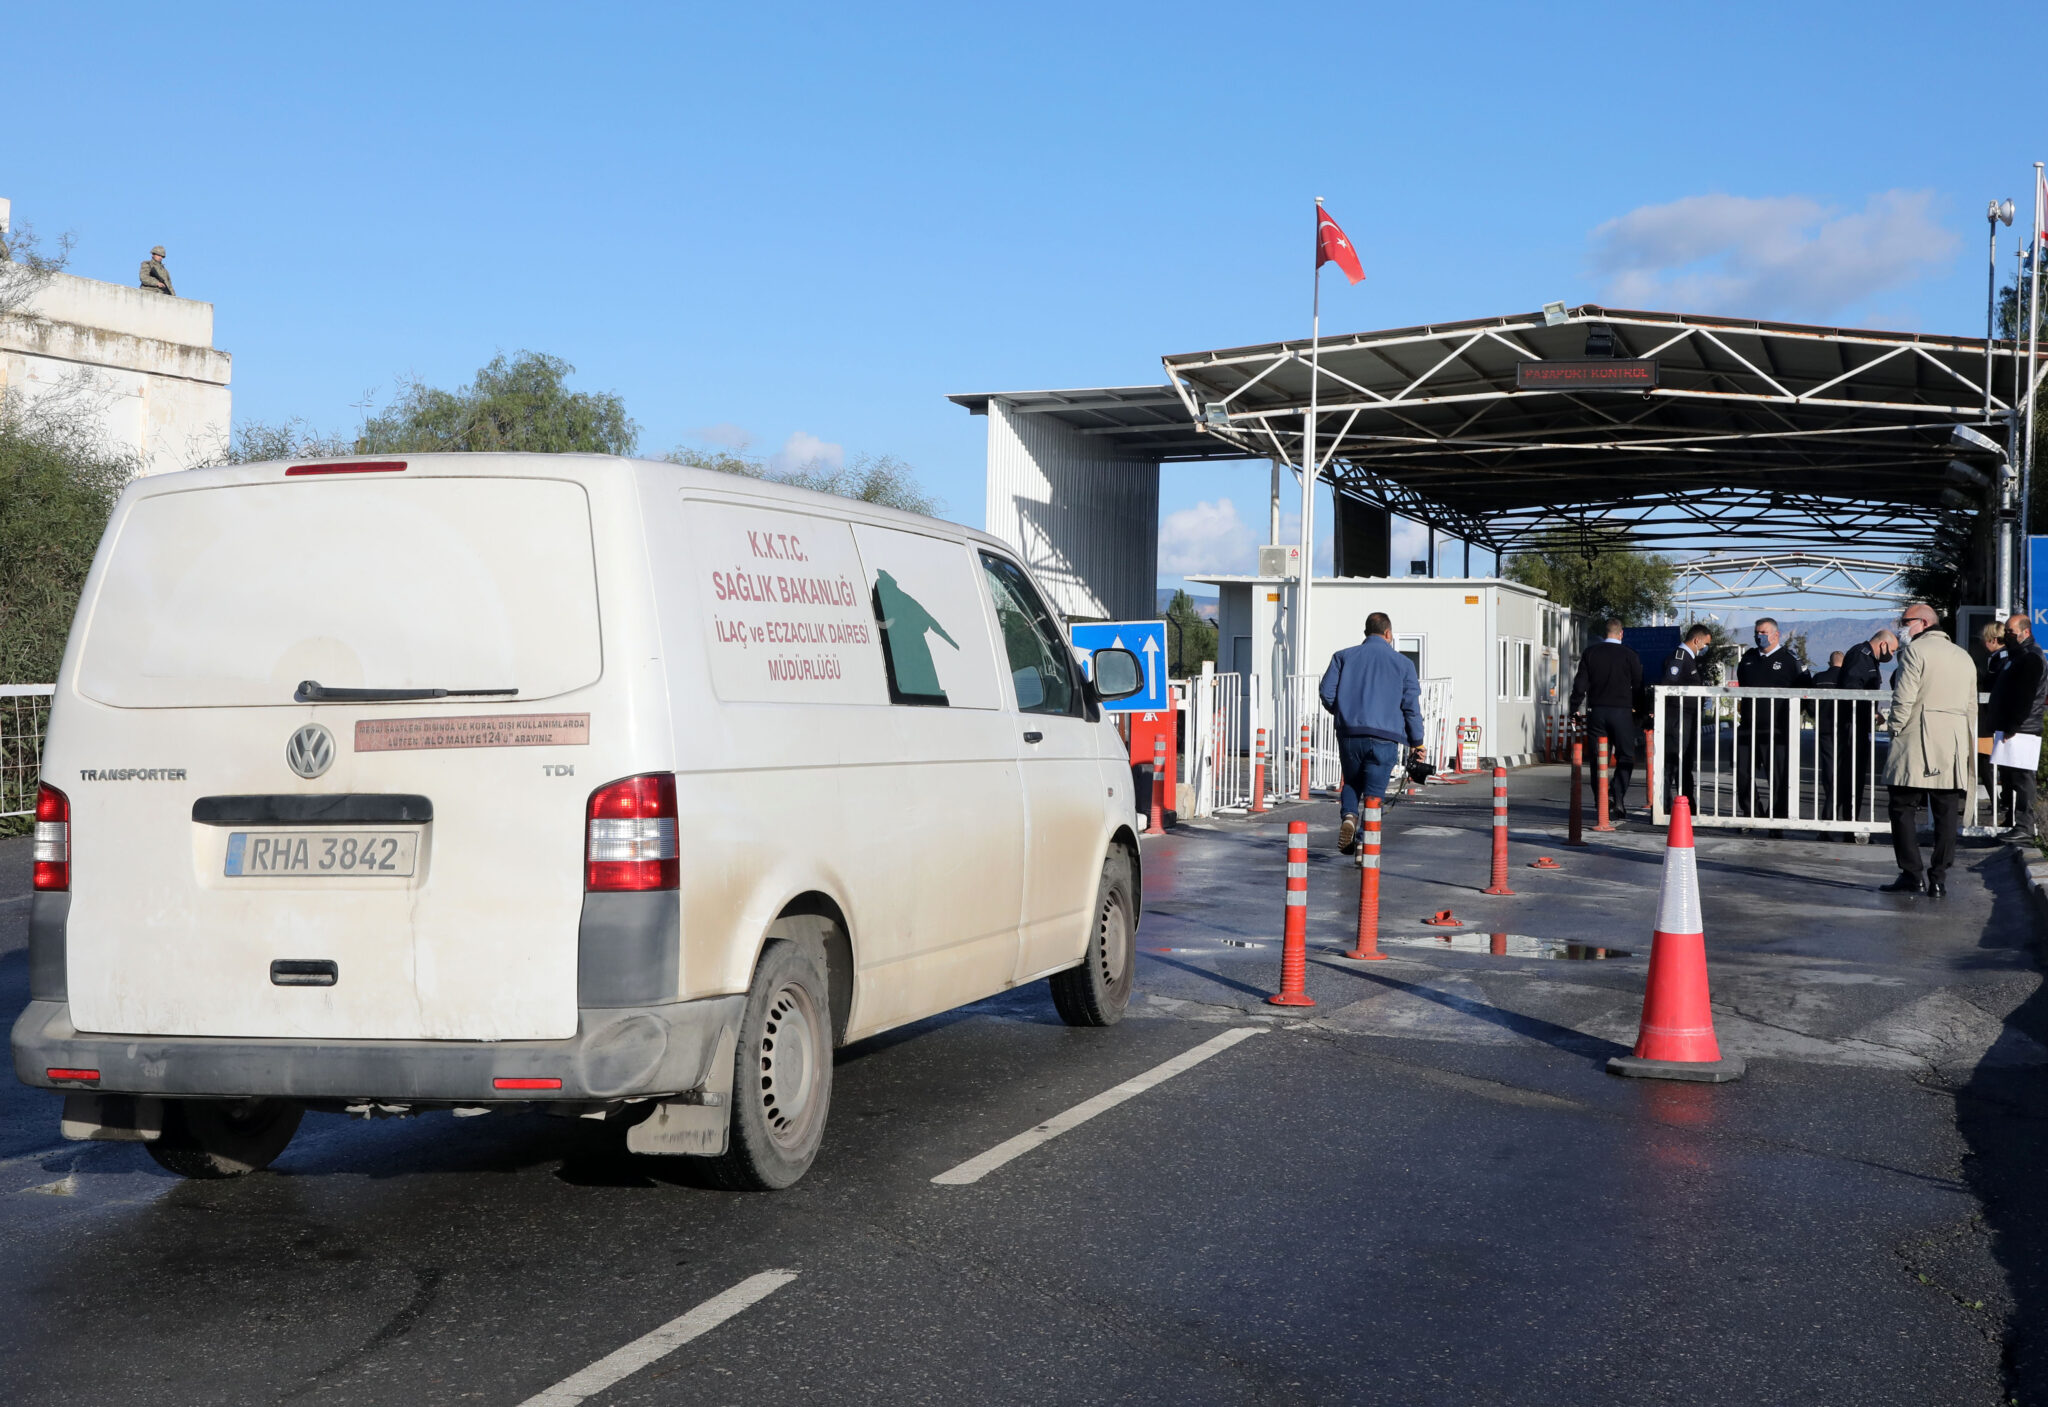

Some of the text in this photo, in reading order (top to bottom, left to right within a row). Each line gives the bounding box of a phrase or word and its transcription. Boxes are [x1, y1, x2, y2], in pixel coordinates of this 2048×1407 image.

[1591, 368, 1648, 378] KONTROL
[747, 530, 809, 562] K.K.T.C.
[712, 564, 857, 607] SAĞLIK BAKANLIĞI
[714, 614, 870, 648] İLAÇ ve ECZACILIK DAİRESİ
[767, 653, 841, 681] MÜDÜRLÜĞÜ
[469, 720, 496, 731] KURAL
[516, 719, 585, 730] KULLANIMLARDA
[514, 733, 553, 743] ARAYINIZ
[80, 769, 187, 781] TRANSPORTER
[251, 837, 398, 870] RHA 3842
